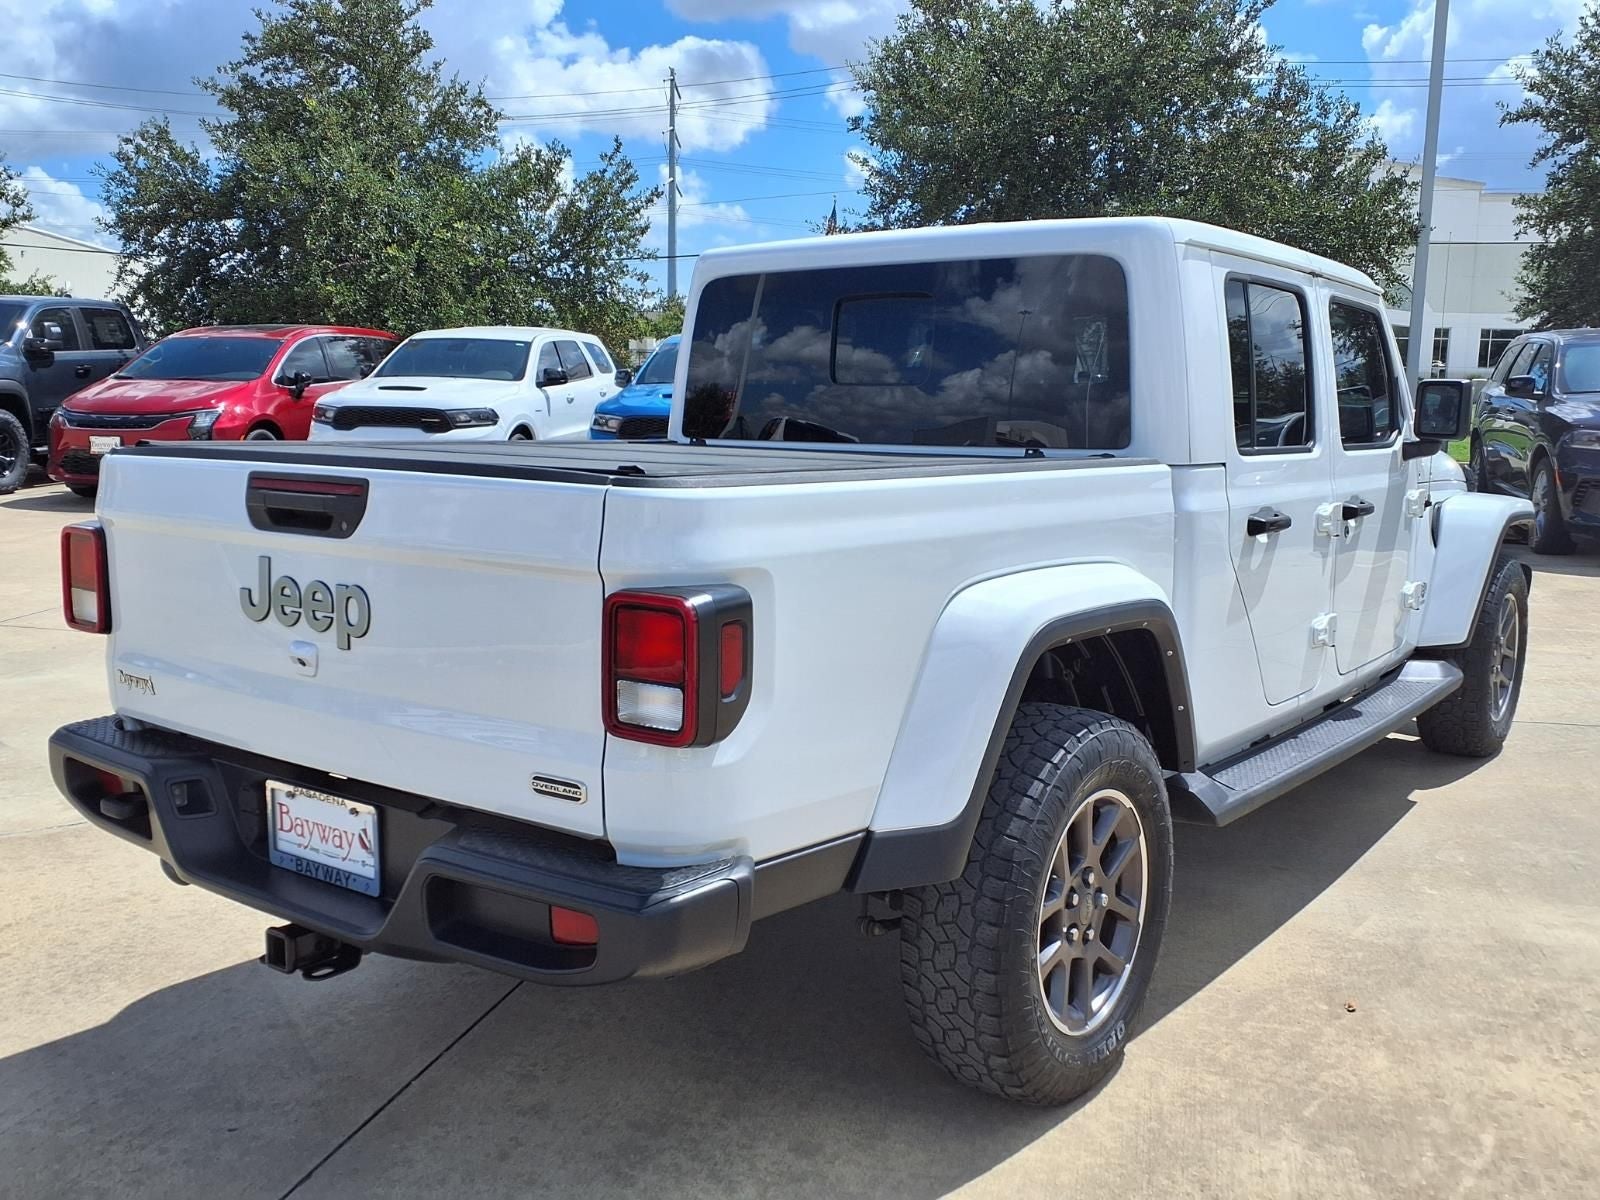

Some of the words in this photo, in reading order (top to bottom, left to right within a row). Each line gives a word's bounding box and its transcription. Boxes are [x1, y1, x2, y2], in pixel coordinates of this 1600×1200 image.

[240, 556, 371, 650] Jeep
[293, 787, 347, 807] PASADENA
[531, 781, 582, 797] OVERLAND
[277, 801, 355, 862] Bayway
[296, 858, 353, 887] BAYWAY
